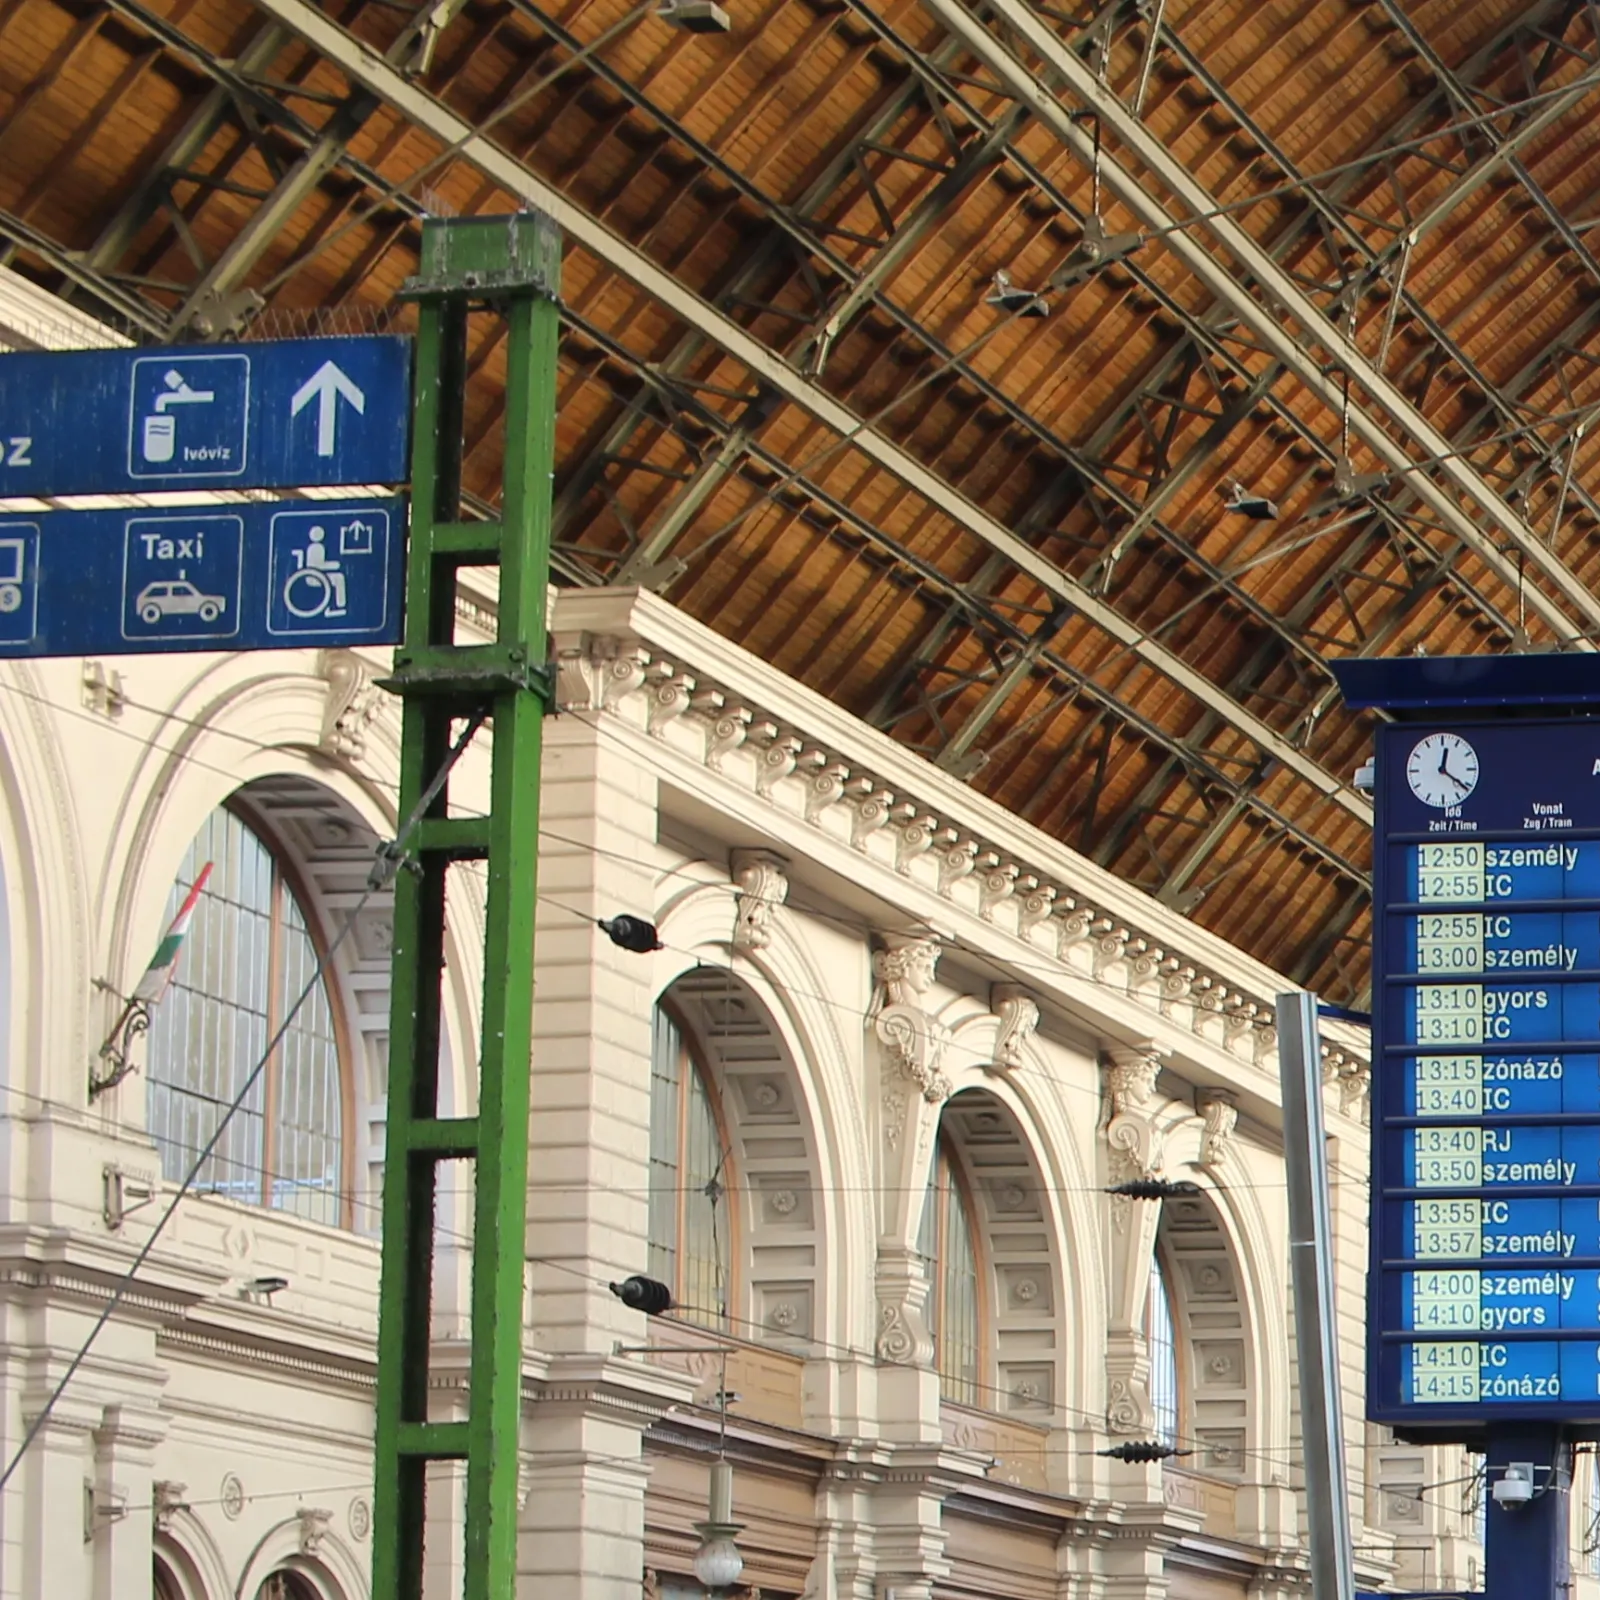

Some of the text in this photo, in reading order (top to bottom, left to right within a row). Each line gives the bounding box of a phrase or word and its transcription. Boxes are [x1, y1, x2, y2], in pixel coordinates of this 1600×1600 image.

[183, 446, 231, 461] Ivóvíz
[141, 532, 204, 560] Taxi
[1533, 802, 1563, 816] Vonat
[1429, 819, 1478, 831] Zeit Time
[1524, 817, 1572, 831] Zug Train
[1420, 847, 1479, 869] 12:50
[1485, 843, 1578, 871] személy
[1418, 947, 1477, 968] 13:00
[1484, 944, 1578, 971] személy
[1417, 1017, 1477, 1039] 13:10
[1484, 1016, 1511, 1039] IC
[1416, 1160, 1476, 1182] 13:50
[1483, 1158, 1576, 1185] személy
[1414, 1274, 1474, 1295] 14:00
[1481, 1273, 1575, 1300] személy
[1413, 1345, 1474, 1367] 14:10
[1480, 1344, 1507, 1367] IC
[1413, 1375, 1474, 1397] 14:15
[1480, 1374, 1561, 1397] zónázó
